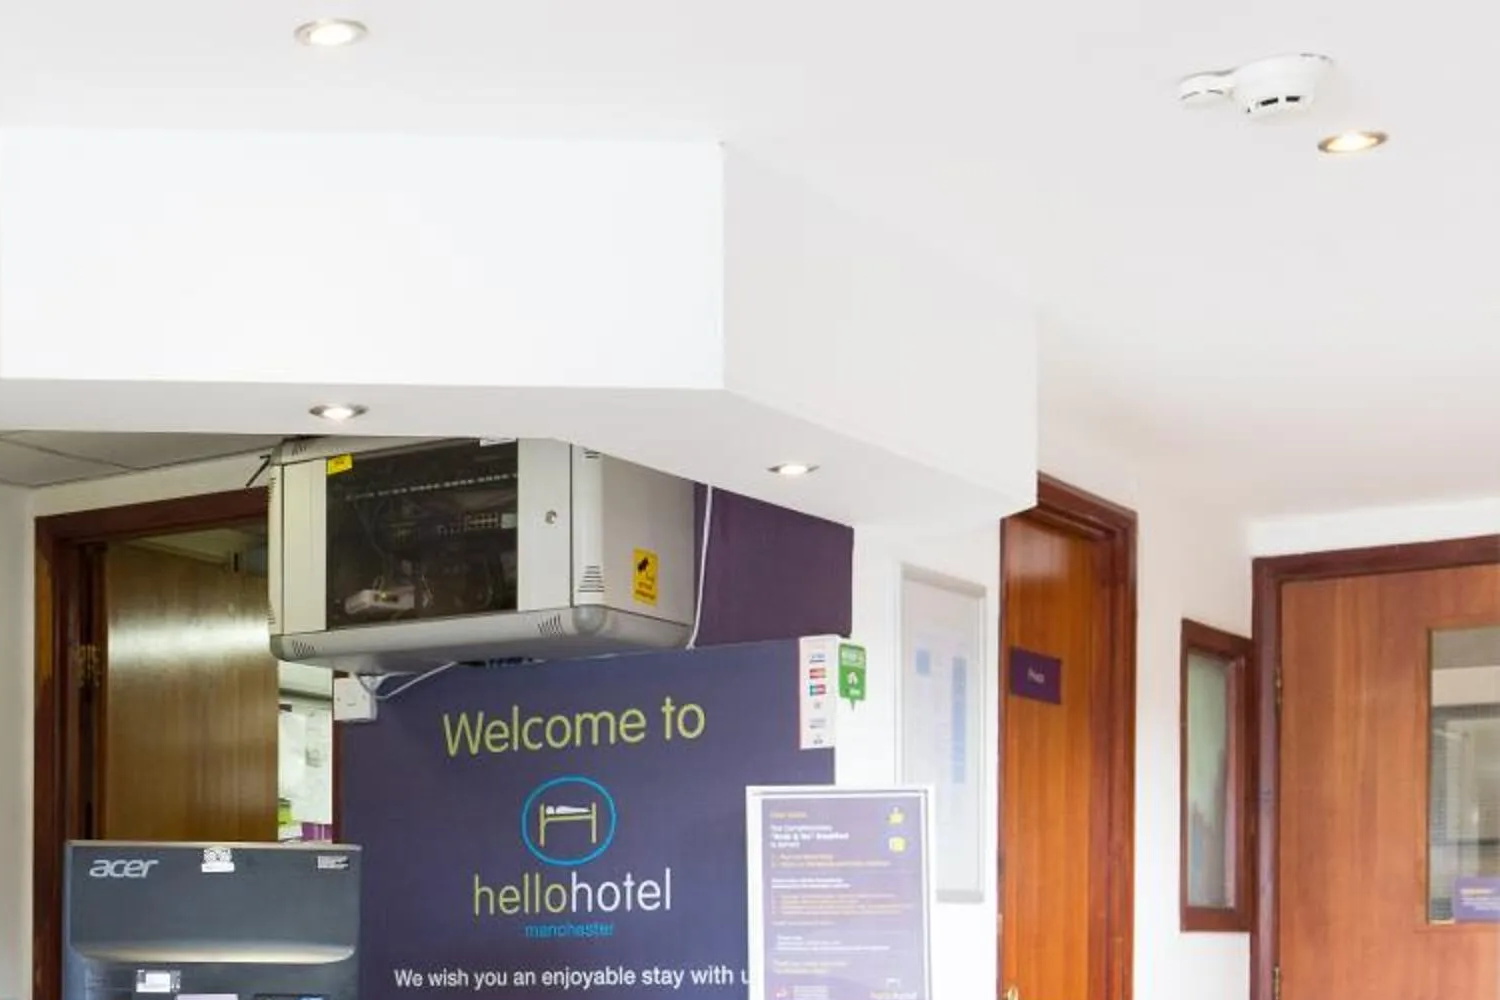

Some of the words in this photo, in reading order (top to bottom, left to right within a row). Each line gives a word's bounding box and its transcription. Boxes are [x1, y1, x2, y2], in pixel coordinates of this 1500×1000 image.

[443, 705, 646, 757] Welcome
[661, 697, 705, 741] to
[89, 858, 159, 878] acer
[473, 867, 671, 916] hellohotel
[394, 969, 424, 987] We
[428, 968, 469, 986] wish
[473, 971, 507, 990] you
[513, 971, 536, 985] an
[542, 966, 636, 989] enjoyable
[642, 967, 684, 988] stay
[691, 965, 734, 984] with
